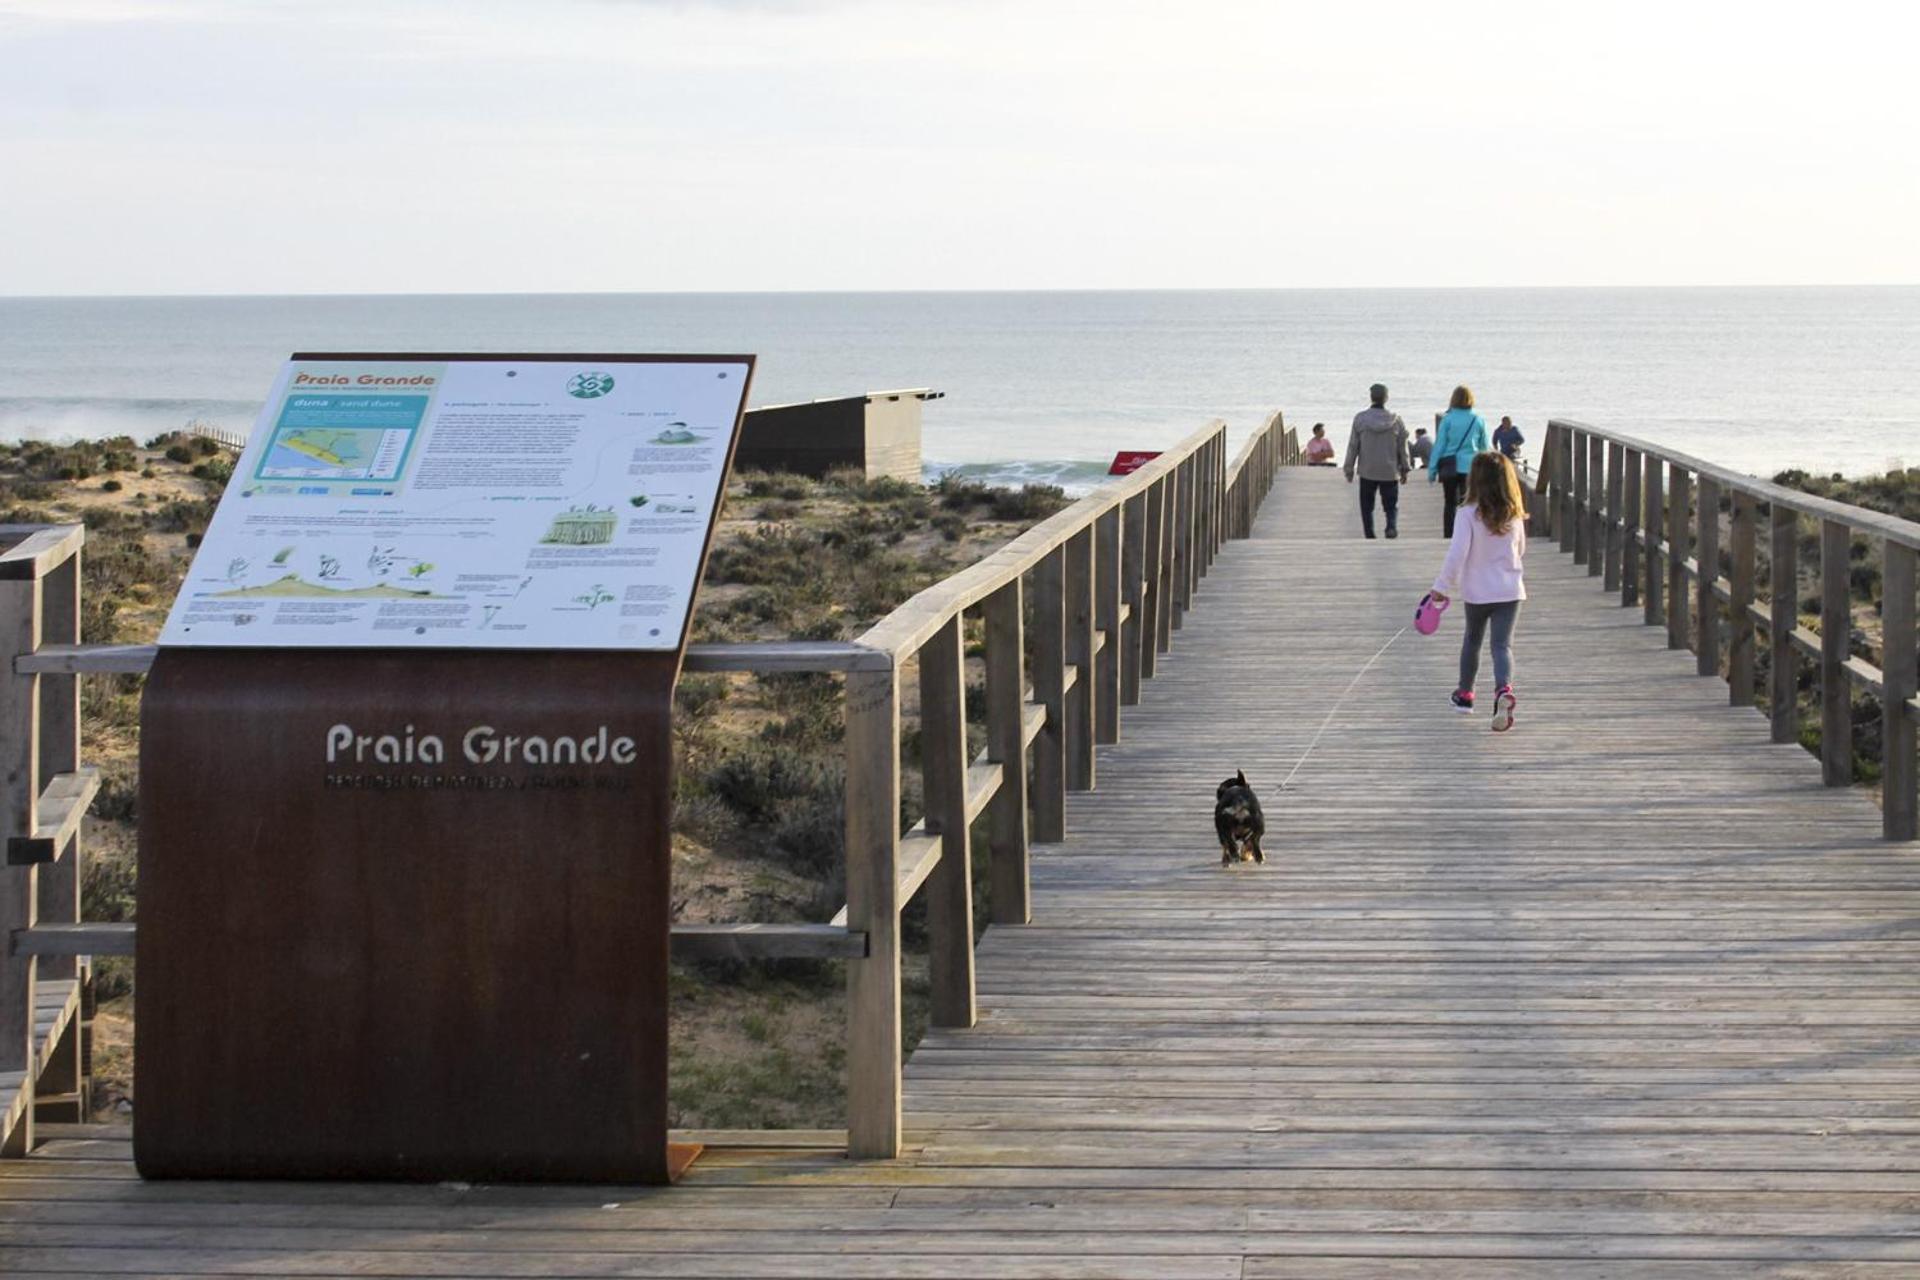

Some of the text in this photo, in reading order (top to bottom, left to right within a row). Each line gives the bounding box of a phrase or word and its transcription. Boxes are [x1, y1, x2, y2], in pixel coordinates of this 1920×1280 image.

[295, 374, 436, 385] Praia Grande
[294, 399, 328, 407] duna
[327, 723, 638, 764] Praia Grande
